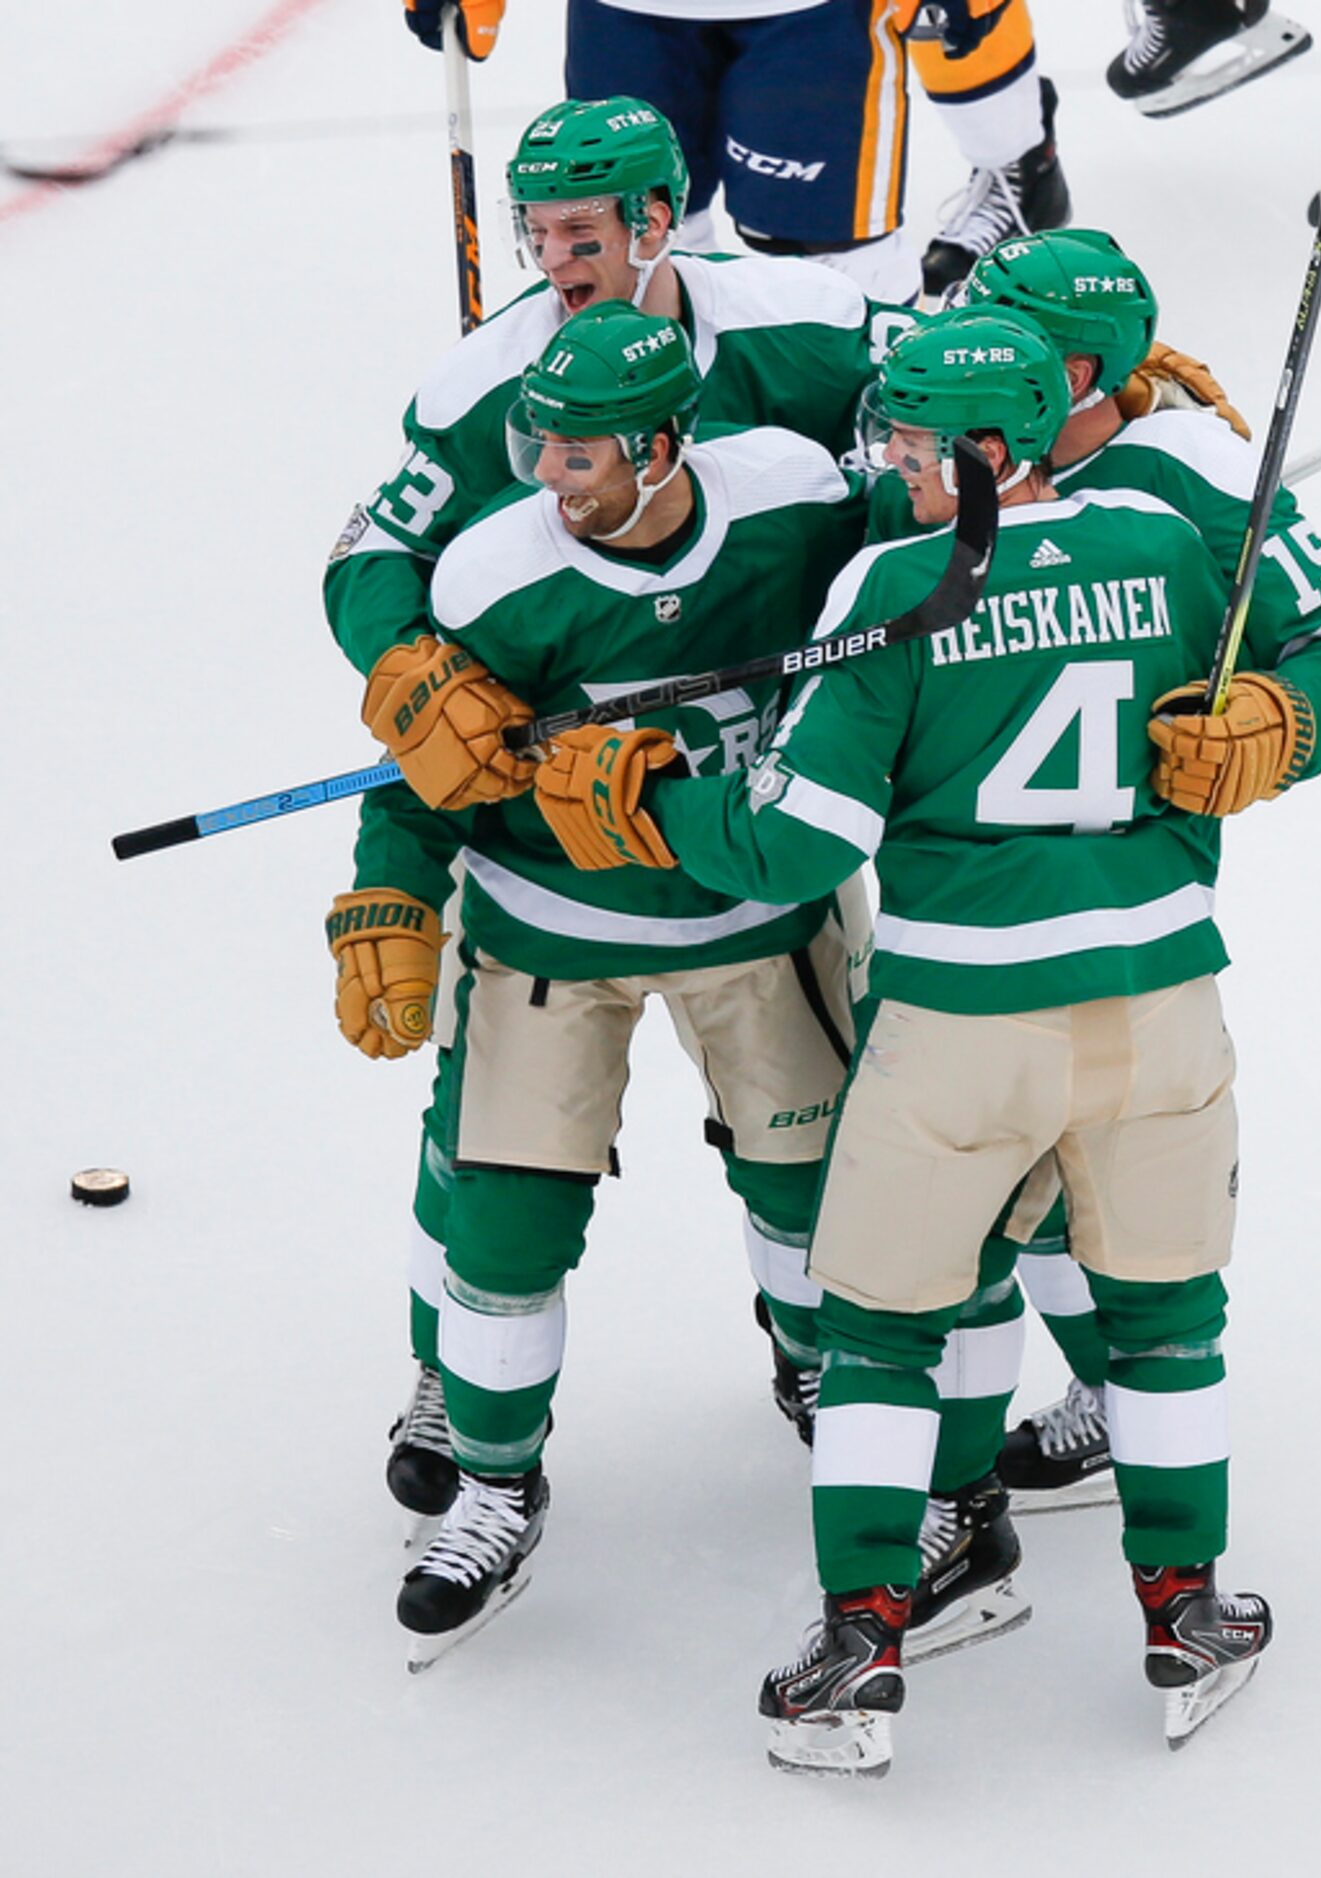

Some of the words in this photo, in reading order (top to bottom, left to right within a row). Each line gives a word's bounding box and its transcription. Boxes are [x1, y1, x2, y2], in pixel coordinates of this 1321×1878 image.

[726, 134, 826, 181] CCM
[547, 350, 575, 376] 11
[930, 576, 1172, 666] HEISKANEN
[975, 659, 1136, 834] 4
